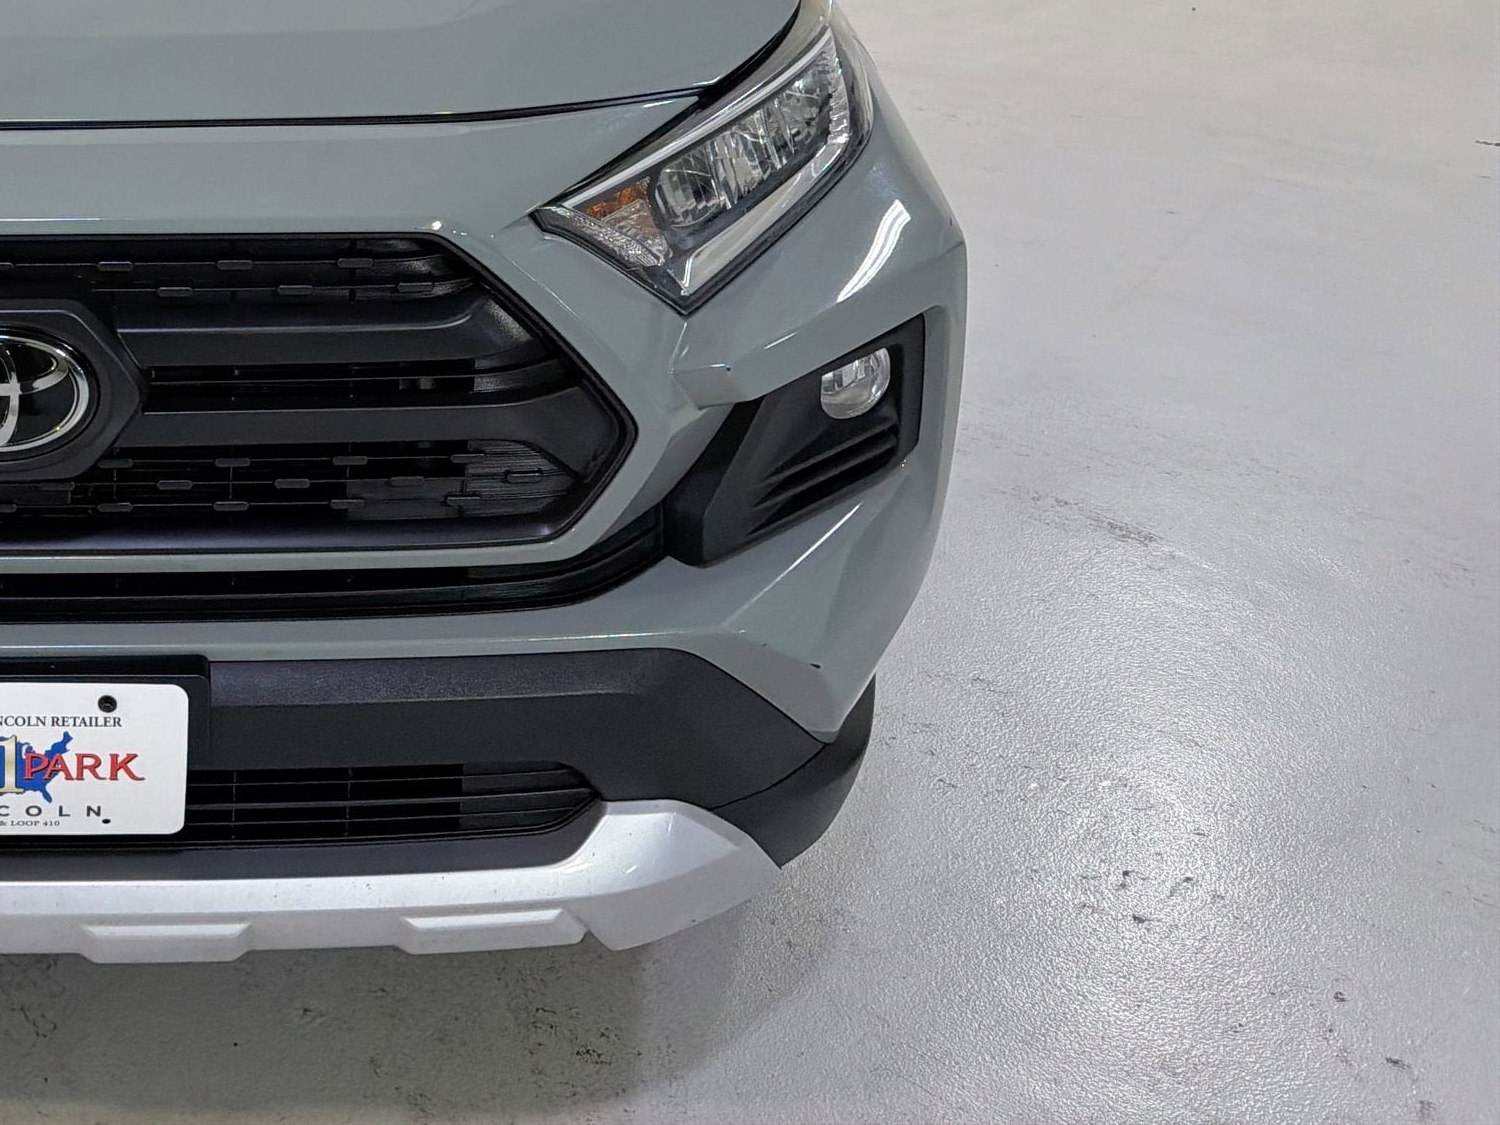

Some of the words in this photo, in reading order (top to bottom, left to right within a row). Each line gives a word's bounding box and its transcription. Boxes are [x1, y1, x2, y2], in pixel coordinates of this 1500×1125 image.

[51, 716, 122, 728] RETAILER
[24, 753, 145, 781] PARK
[10, 819, 41, 827] LOOP
[42, 819, 61, 827] 410
